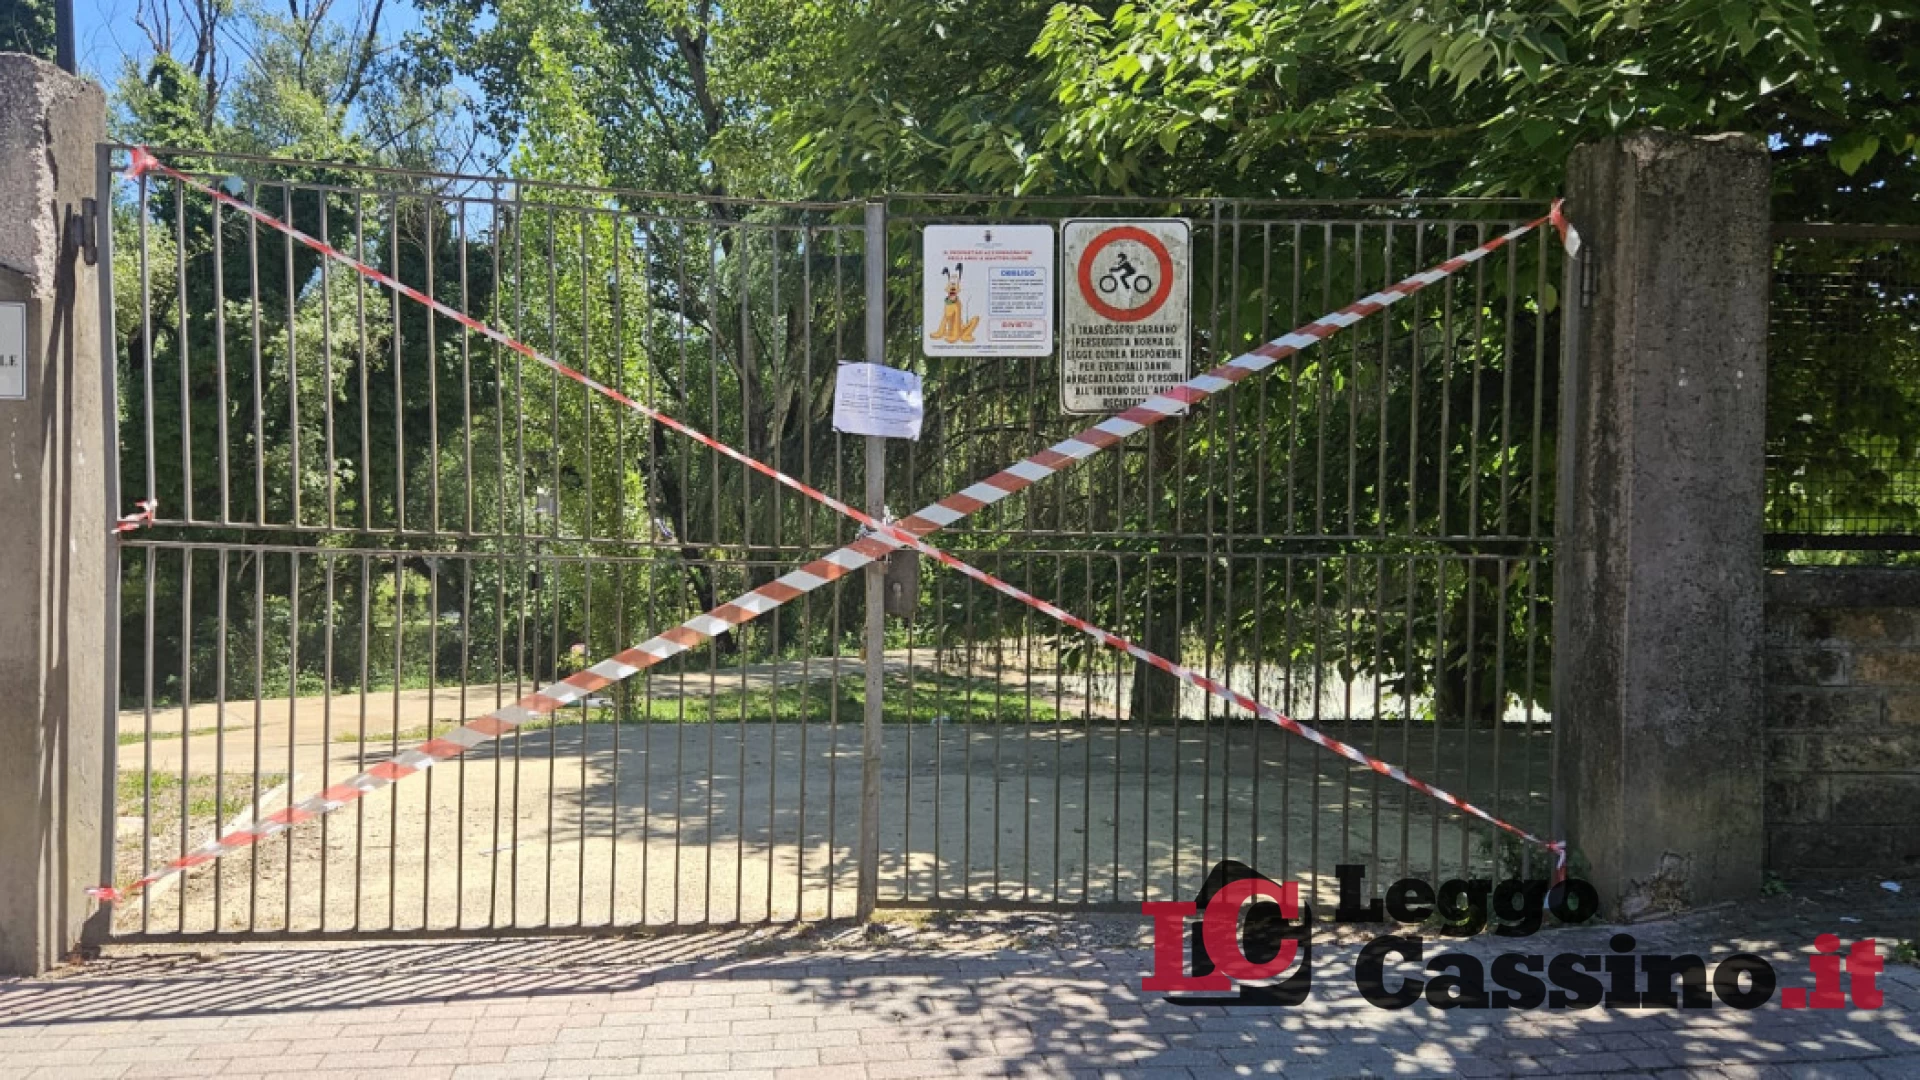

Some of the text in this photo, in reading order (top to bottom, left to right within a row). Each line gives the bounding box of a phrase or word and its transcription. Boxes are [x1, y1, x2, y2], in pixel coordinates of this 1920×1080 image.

[1137, 324, 1177, 335] SARANNO
[1134, 337, 1164, 347] NORMA
[1066, 350, 1092, 360] LEGGE
[1130, 349, 1182, 359] RISPONDERE
[1079, 362, 1095, 372] PER
[1099, 362, 1142, 372] EVENTUALI
[1115, 373, 1135, 383] COSE
[1138, 373, 1144, 382] O
